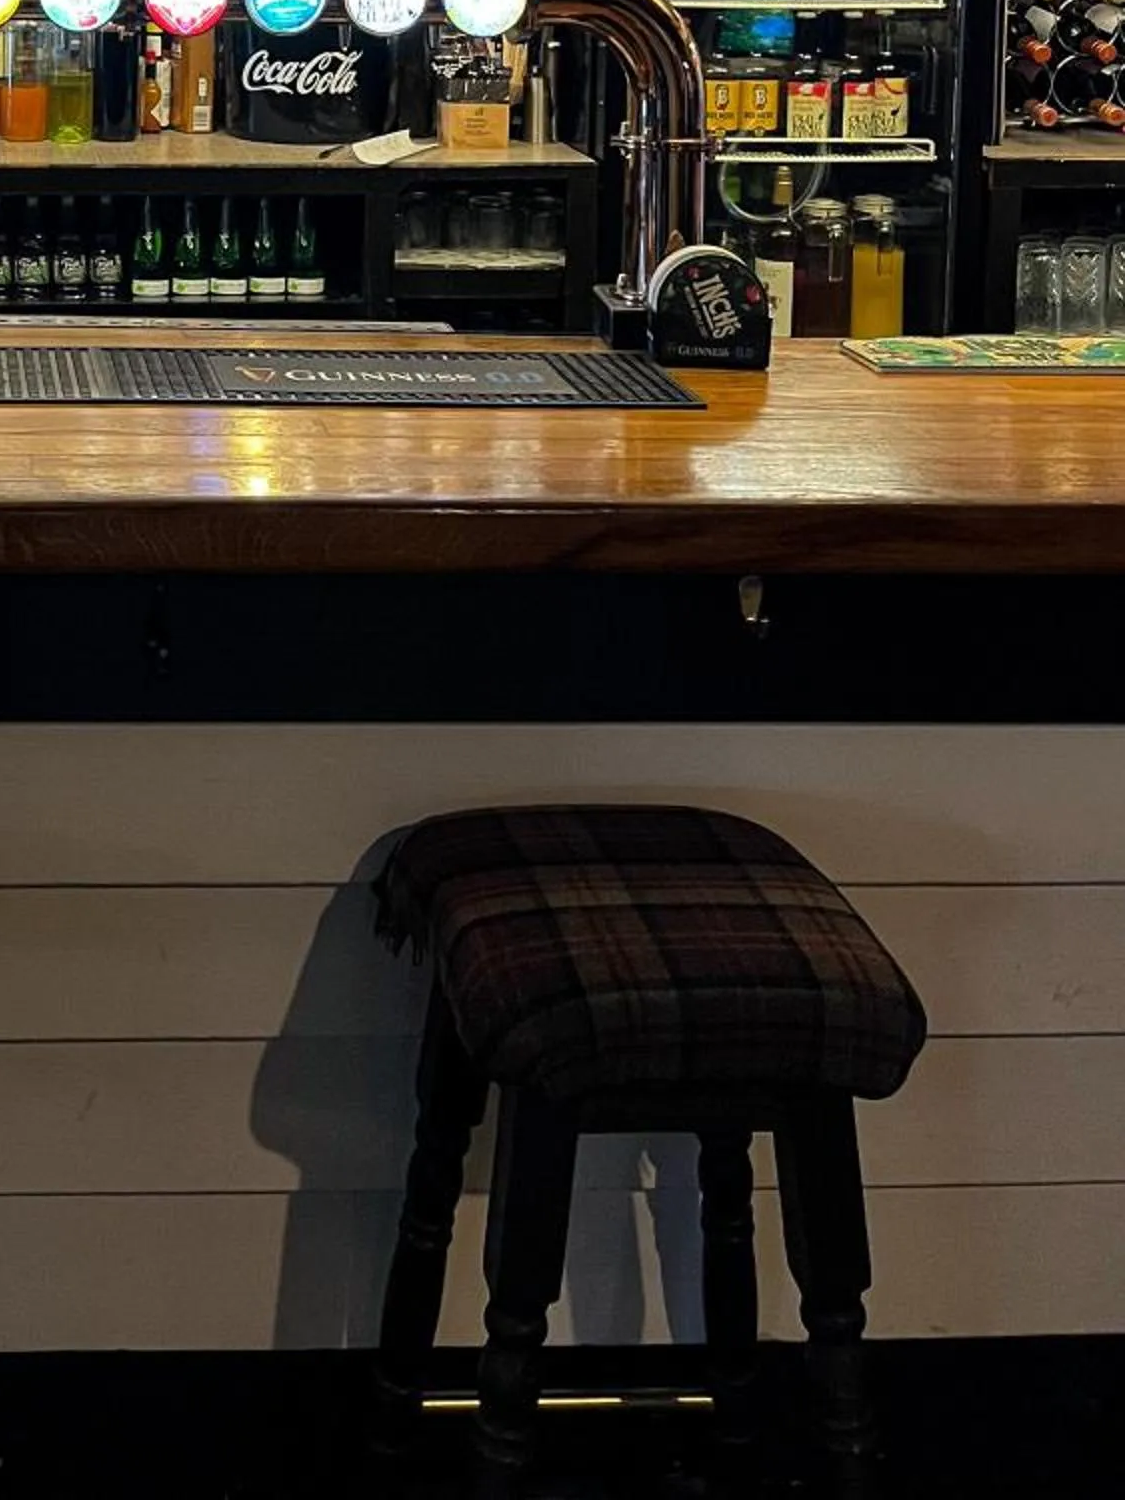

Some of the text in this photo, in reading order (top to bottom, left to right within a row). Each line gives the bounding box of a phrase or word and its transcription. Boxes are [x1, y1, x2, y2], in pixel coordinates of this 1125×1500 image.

[242, 49, 363, 96] Coca-Cola
[692, 273, 742, 339] INCH'S
[284, 369, 476, 383] GUINNESS
